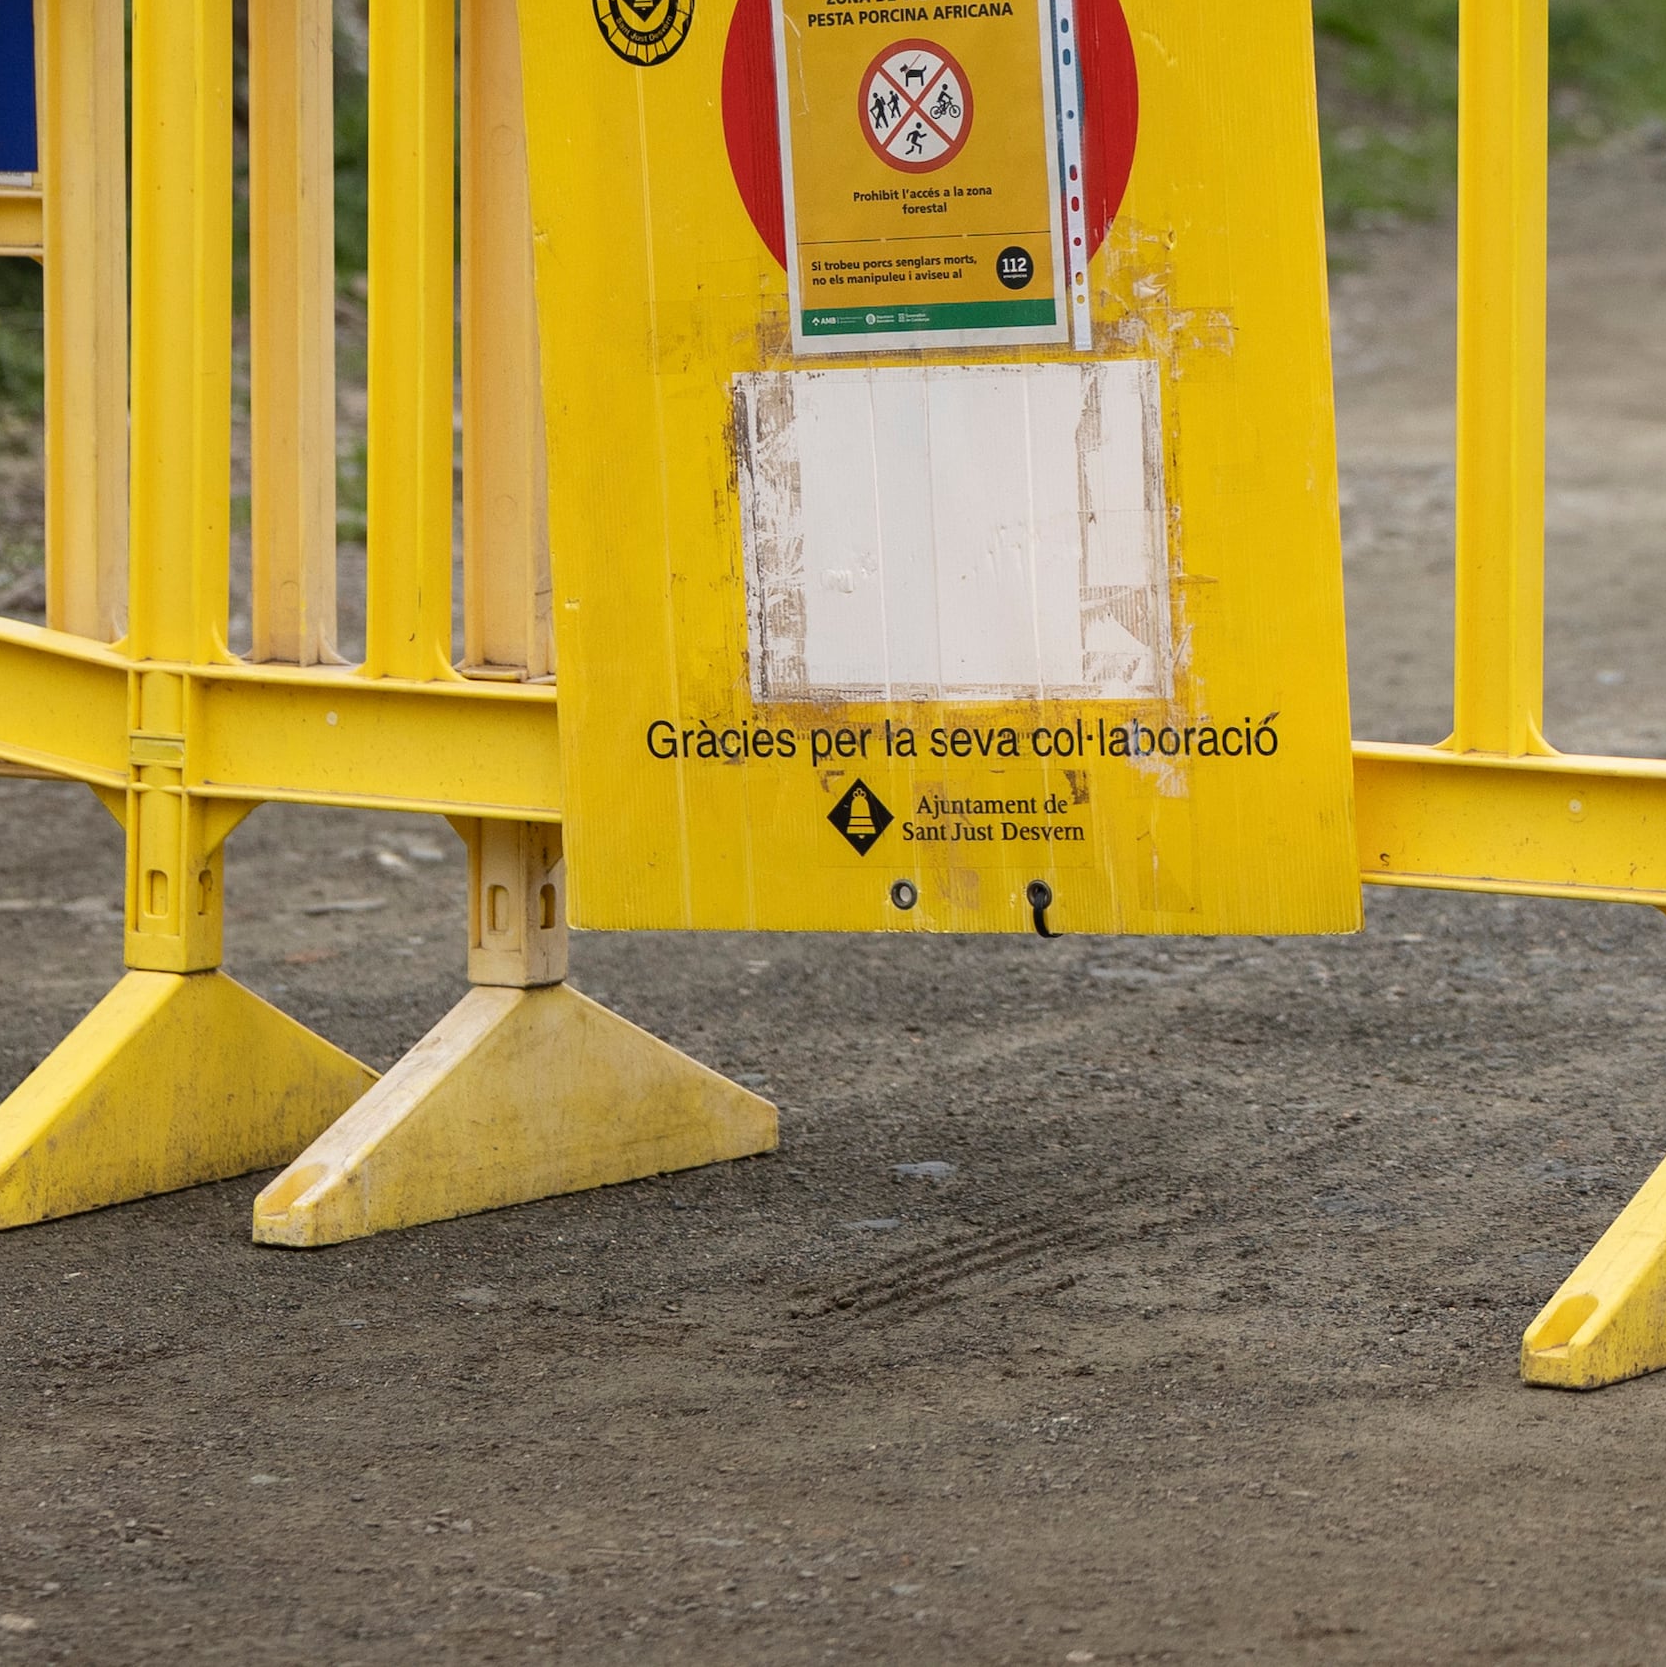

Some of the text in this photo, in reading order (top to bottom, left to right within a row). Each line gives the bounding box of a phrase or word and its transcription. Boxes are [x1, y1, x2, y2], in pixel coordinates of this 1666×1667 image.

[808, 2, 1013, 27] PESTA PORCINA AFRICANA
[853, 190, 899, 202] Prohibit
[943, 189, 951, 198] a
[953, 186, 964, 197] la
[966, 187, 992, 197] zona
[902, 202, 947, 215] forestal
[811, 254, 977, 272] Si trobeu porcs senglars morts,
[1002, 257, 1027, 273] 112
[812, 268, 962, 286] no els manipuleu i aviseu al
[647, 710, 1282, 767] Gràcies per la seva col·laboració
[916, 793, 1068, 819] Ajuntament de
[902, 820, 1086, 842] Sant Just Desvern
